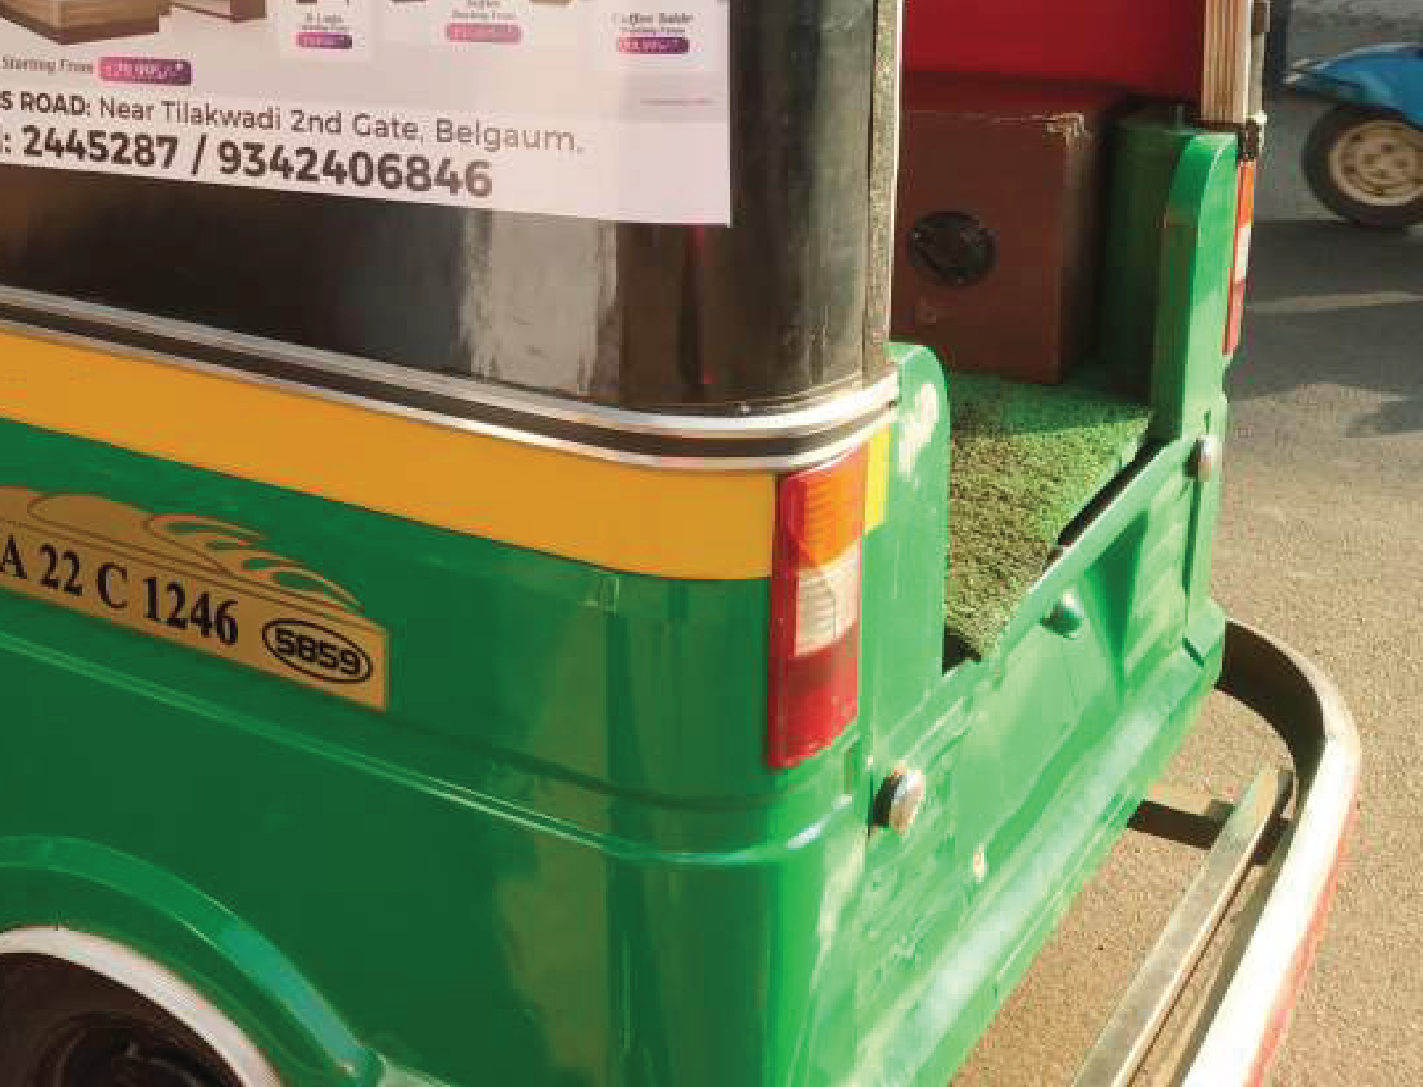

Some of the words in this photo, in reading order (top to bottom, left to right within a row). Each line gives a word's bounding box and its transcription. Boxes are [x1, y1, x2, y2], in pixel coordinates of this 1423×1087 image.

[20, 91, 92, 117] ROAD:
[99, 97, 155, 121] Near
[160, 99, 281, 132] Tilakwadi
[289, 109, 343, 136] 2nd
[22, 124, 179, 170] 2445287
[190, 134, 208, 177] /
[216, 139, 494, 198] 9342406846
[38, 543, 83, 597] 22
[96, 561, 129, 609] C
[141, 576, 240, 646] 1246
